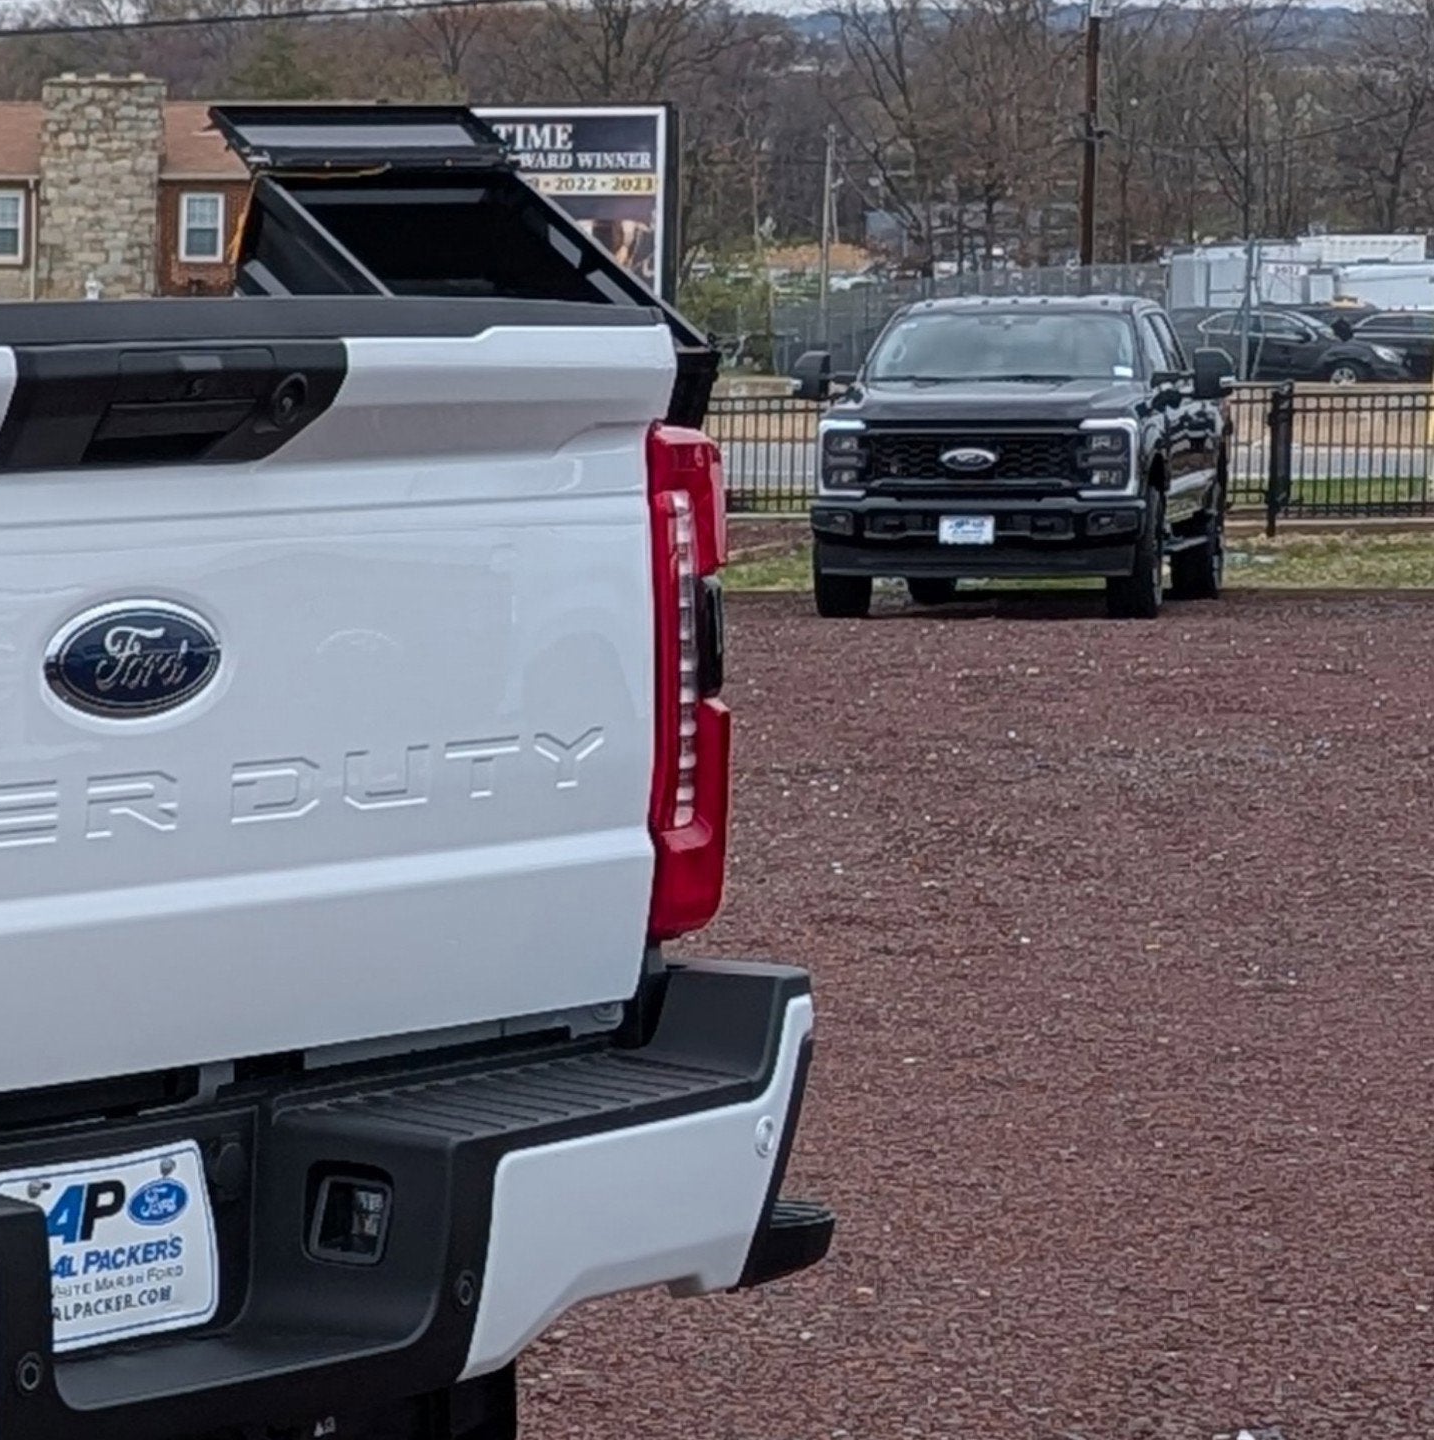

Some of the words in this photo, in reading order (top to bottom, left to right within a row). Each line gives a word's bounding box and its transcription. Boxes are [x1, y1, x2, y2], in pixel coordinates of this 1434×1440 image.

[492, 123, 573, 151] TIME
[507, 152, 572, 169] WARD
[576, 152, 652, 169] WINNER
[555, 176, 596, 191] 2022
[95, 624, 188, 693] Ford
[231, 725, 604, 825] DUTY
